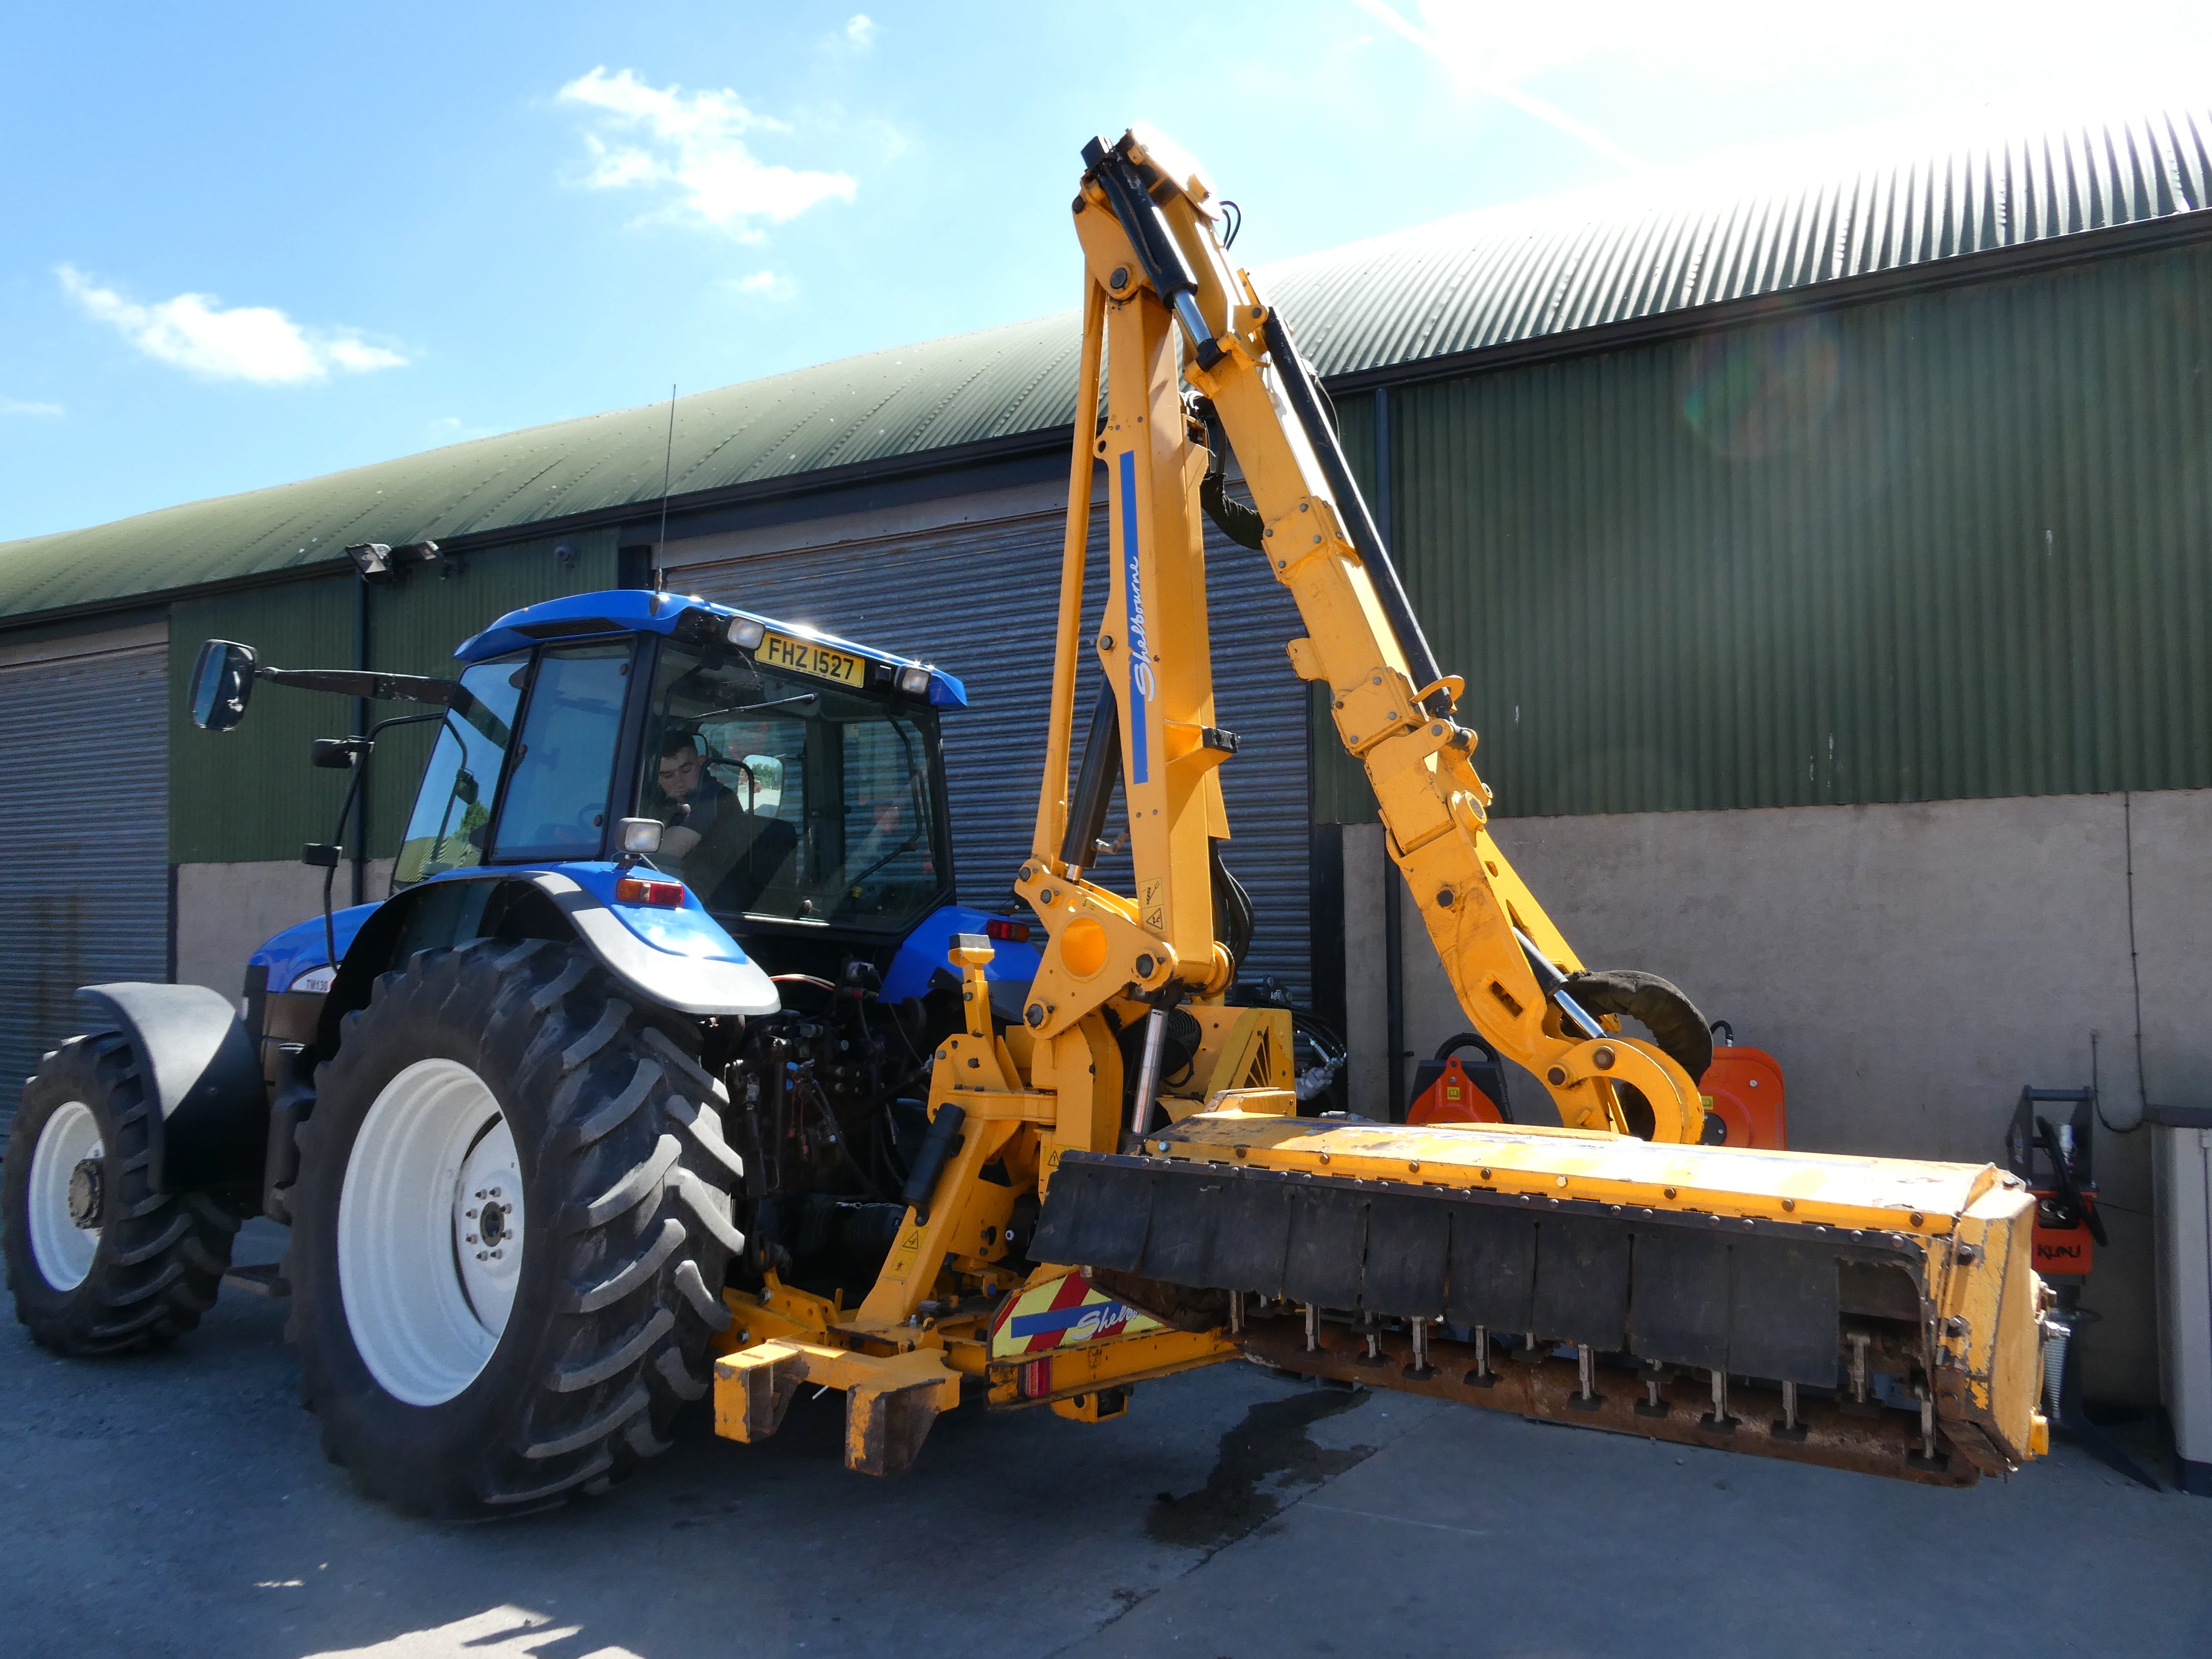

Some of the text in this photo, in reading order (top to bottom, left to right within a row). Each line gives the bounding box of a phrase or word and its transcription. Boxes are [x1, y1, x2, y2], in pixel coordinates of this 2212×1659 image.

[768, 637, 854, 680] FHZ 1527
[1129, 556, 1155, 701] Shelbourne
